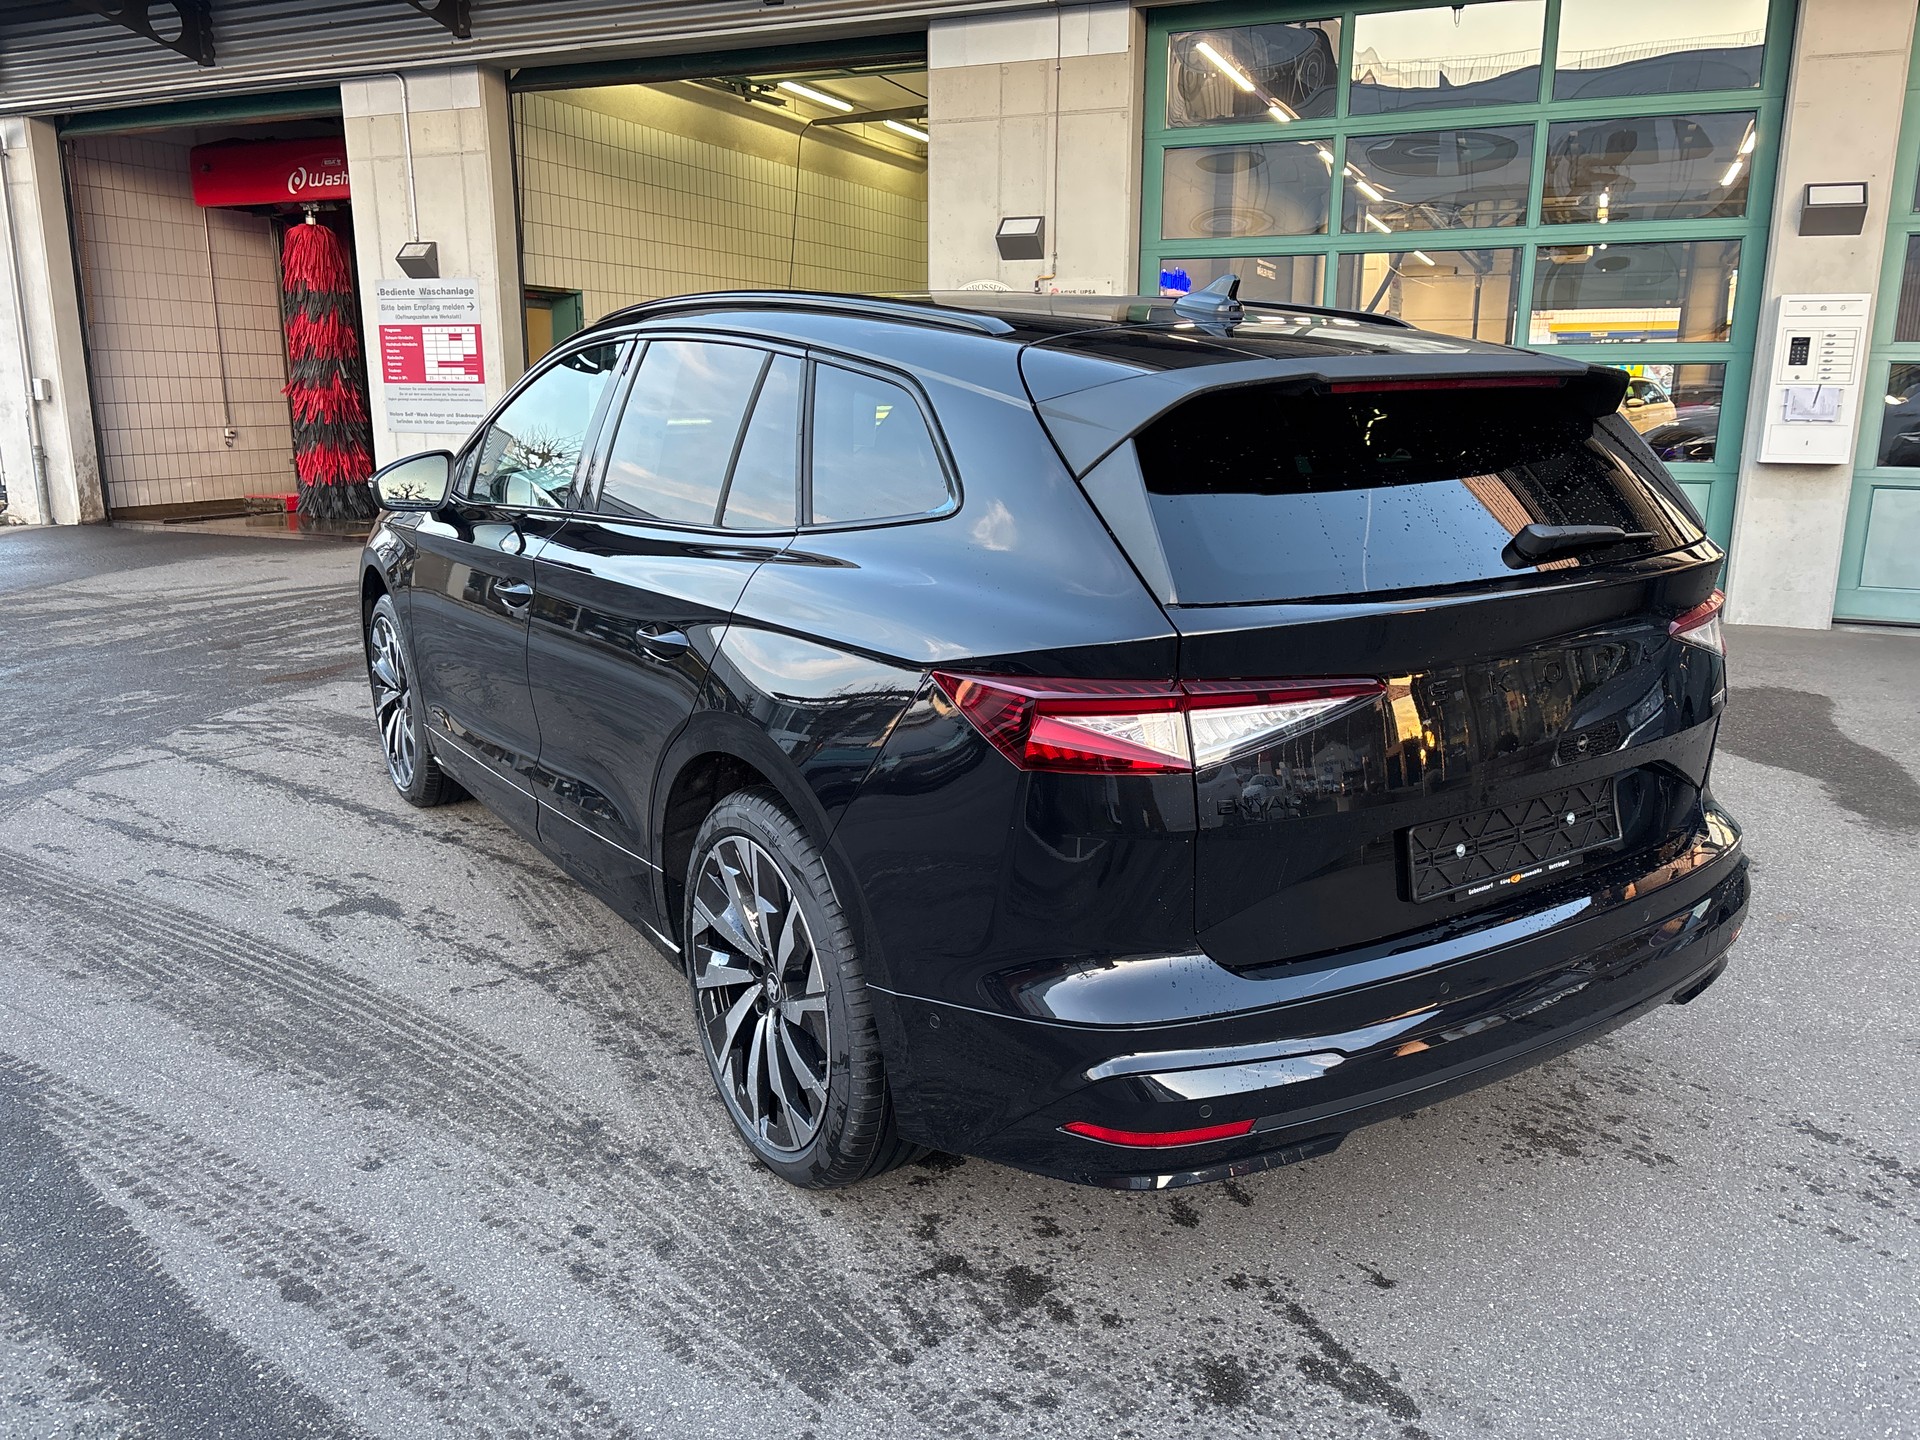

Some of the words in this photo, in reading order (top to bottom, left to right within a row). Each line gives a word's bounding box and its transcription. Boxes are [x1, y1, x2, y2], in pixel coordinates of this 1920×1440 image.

[308, 170, 349, 187] Wash
[380, 288, 415, 296] Bediente
[419, 287, 475, 297] Waschanlage
[413, 303, 440, 312] Empfang
